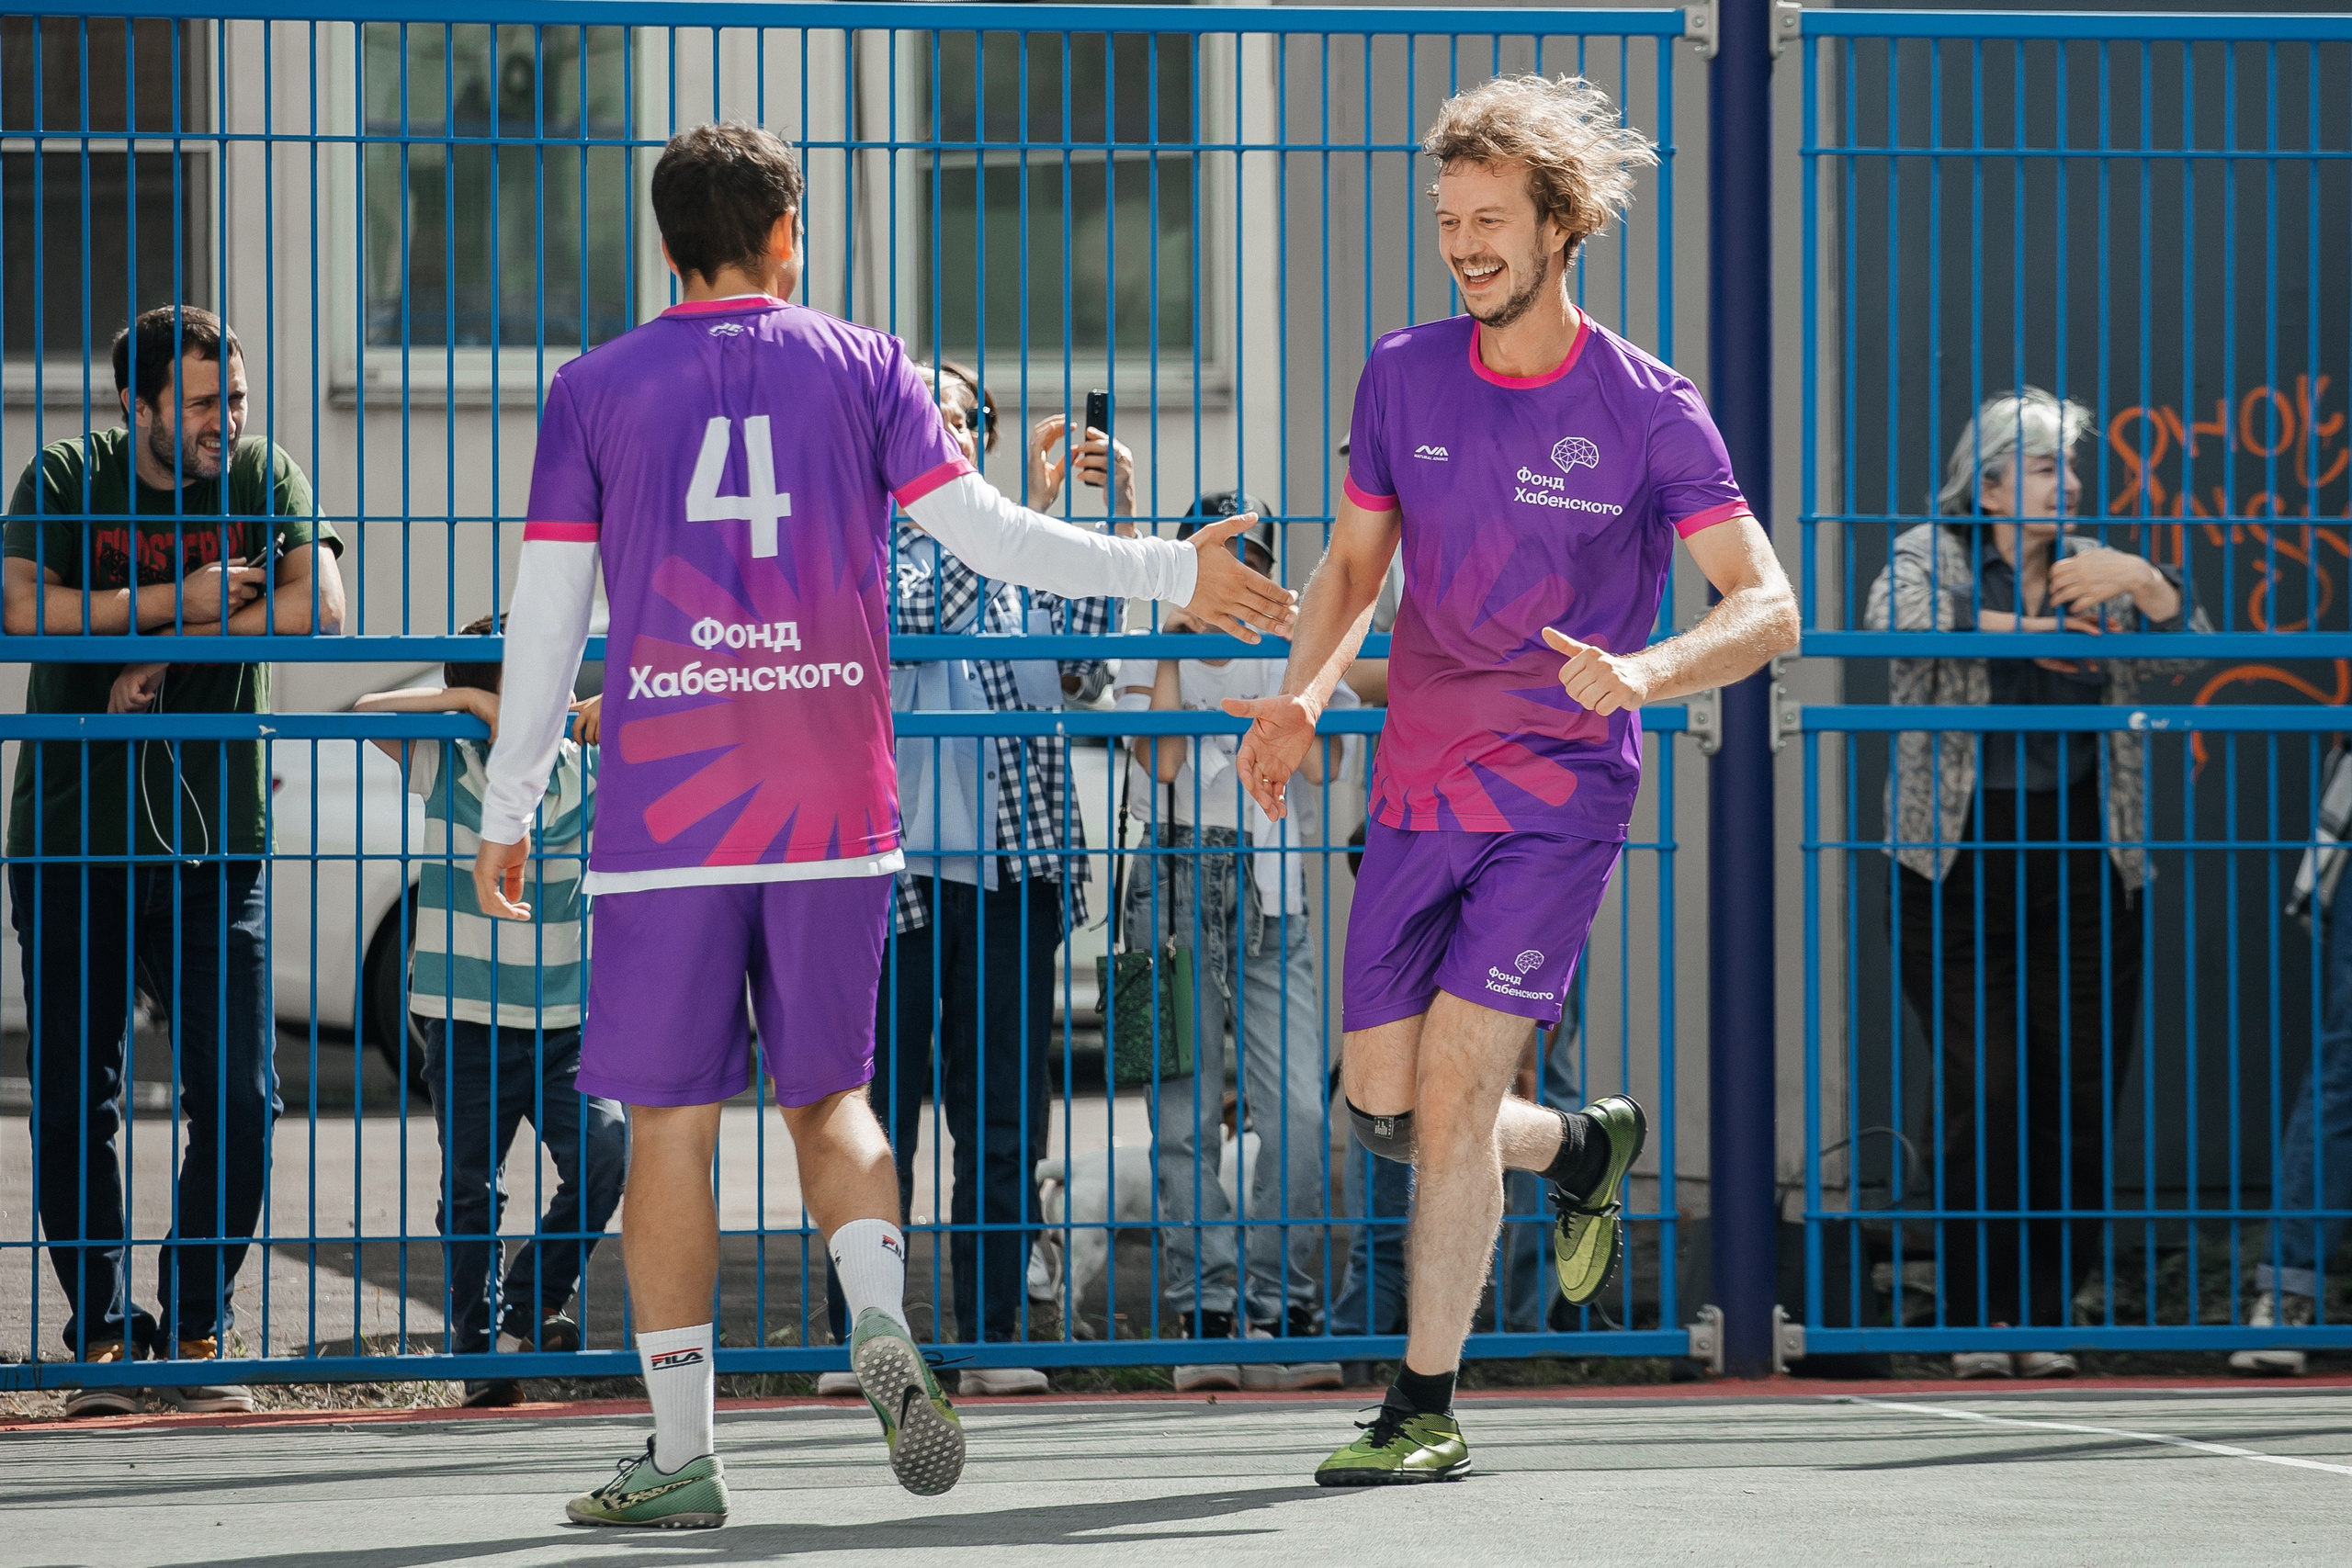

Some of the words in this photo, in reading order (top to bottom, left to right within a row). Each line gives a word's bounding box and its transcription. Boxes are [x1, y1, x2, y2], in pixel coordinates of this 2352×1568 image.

[685, 414, 792, 558] 4
[1516, 466, 1565, 491] Фонд
[1513, 487, 1623, 516] Хабенского
[691, 616, 801, 653] Фонд
[628, 660, 865, 700] Хабенского
[1485, 978, 1555, 1000] Хабенского
[1488, 965, 1522, 986] Фонд
[650, 1348, 704, 1370] FILA
